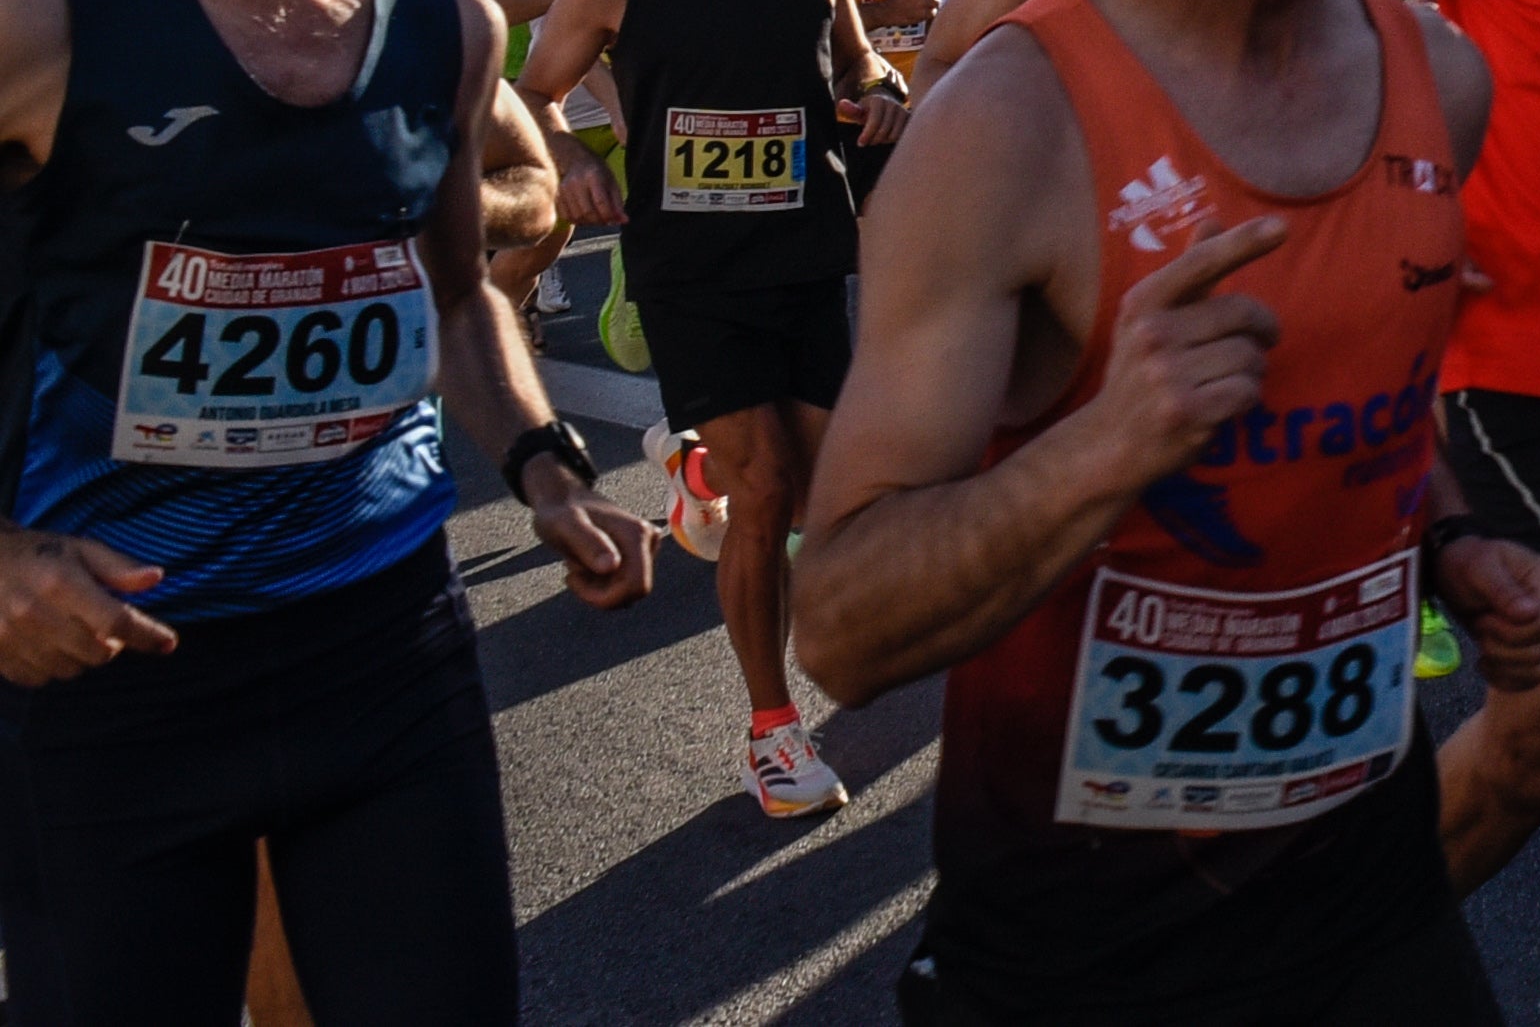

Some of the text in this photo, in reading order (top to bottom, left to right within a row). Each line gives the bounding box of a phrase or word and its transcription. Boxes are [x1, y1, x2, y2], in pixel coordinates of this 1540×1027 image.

[673, 113, 696, 135] 40
[675, 139, 787, 179] 1218
[157, 252, 208, 301] 40
[207, 270, 255, 289] MEDIA
[140, 302, 400, 397] 4260
[1107, 589, 1165, 645] 40
[1092, 642, 1377, 754] 3288
